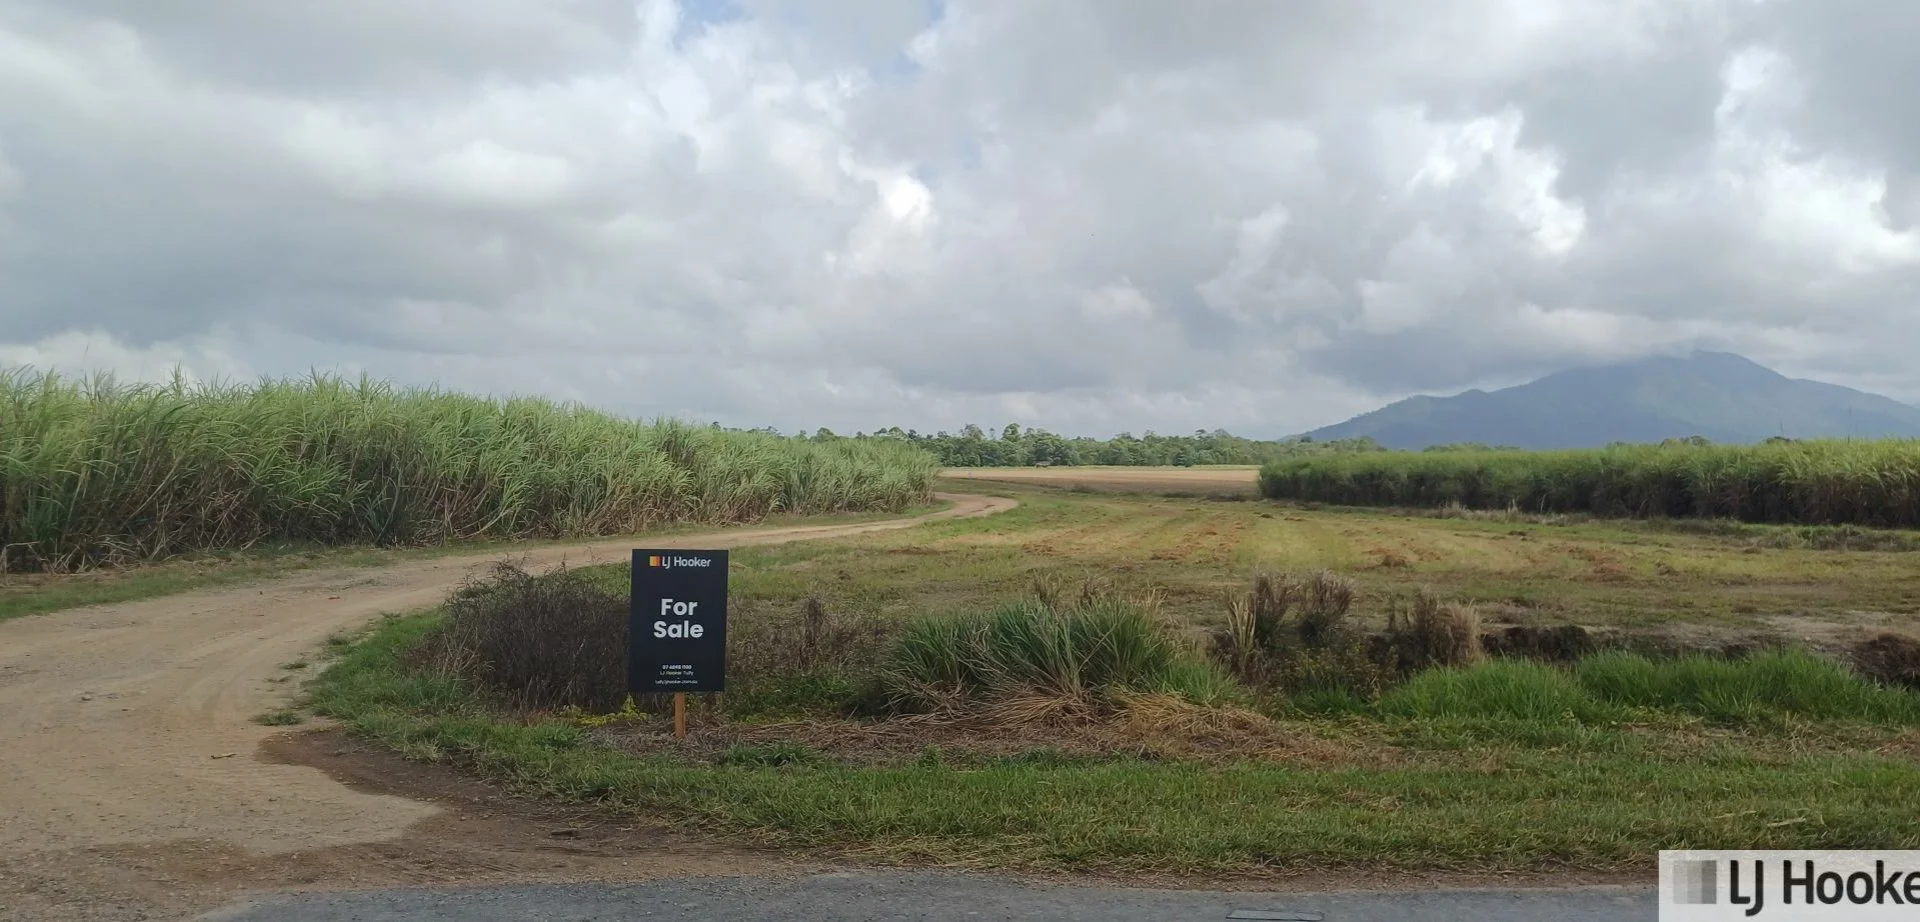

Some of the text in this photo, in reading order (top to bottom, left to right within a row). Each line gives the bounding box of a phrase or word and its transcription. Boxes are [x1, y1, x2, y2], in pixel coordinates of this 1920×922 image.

[662, 556, 711, 569] LJ Hooker
[660, 598, 698, 616] For
[653, 620, 704, 639] Sale
